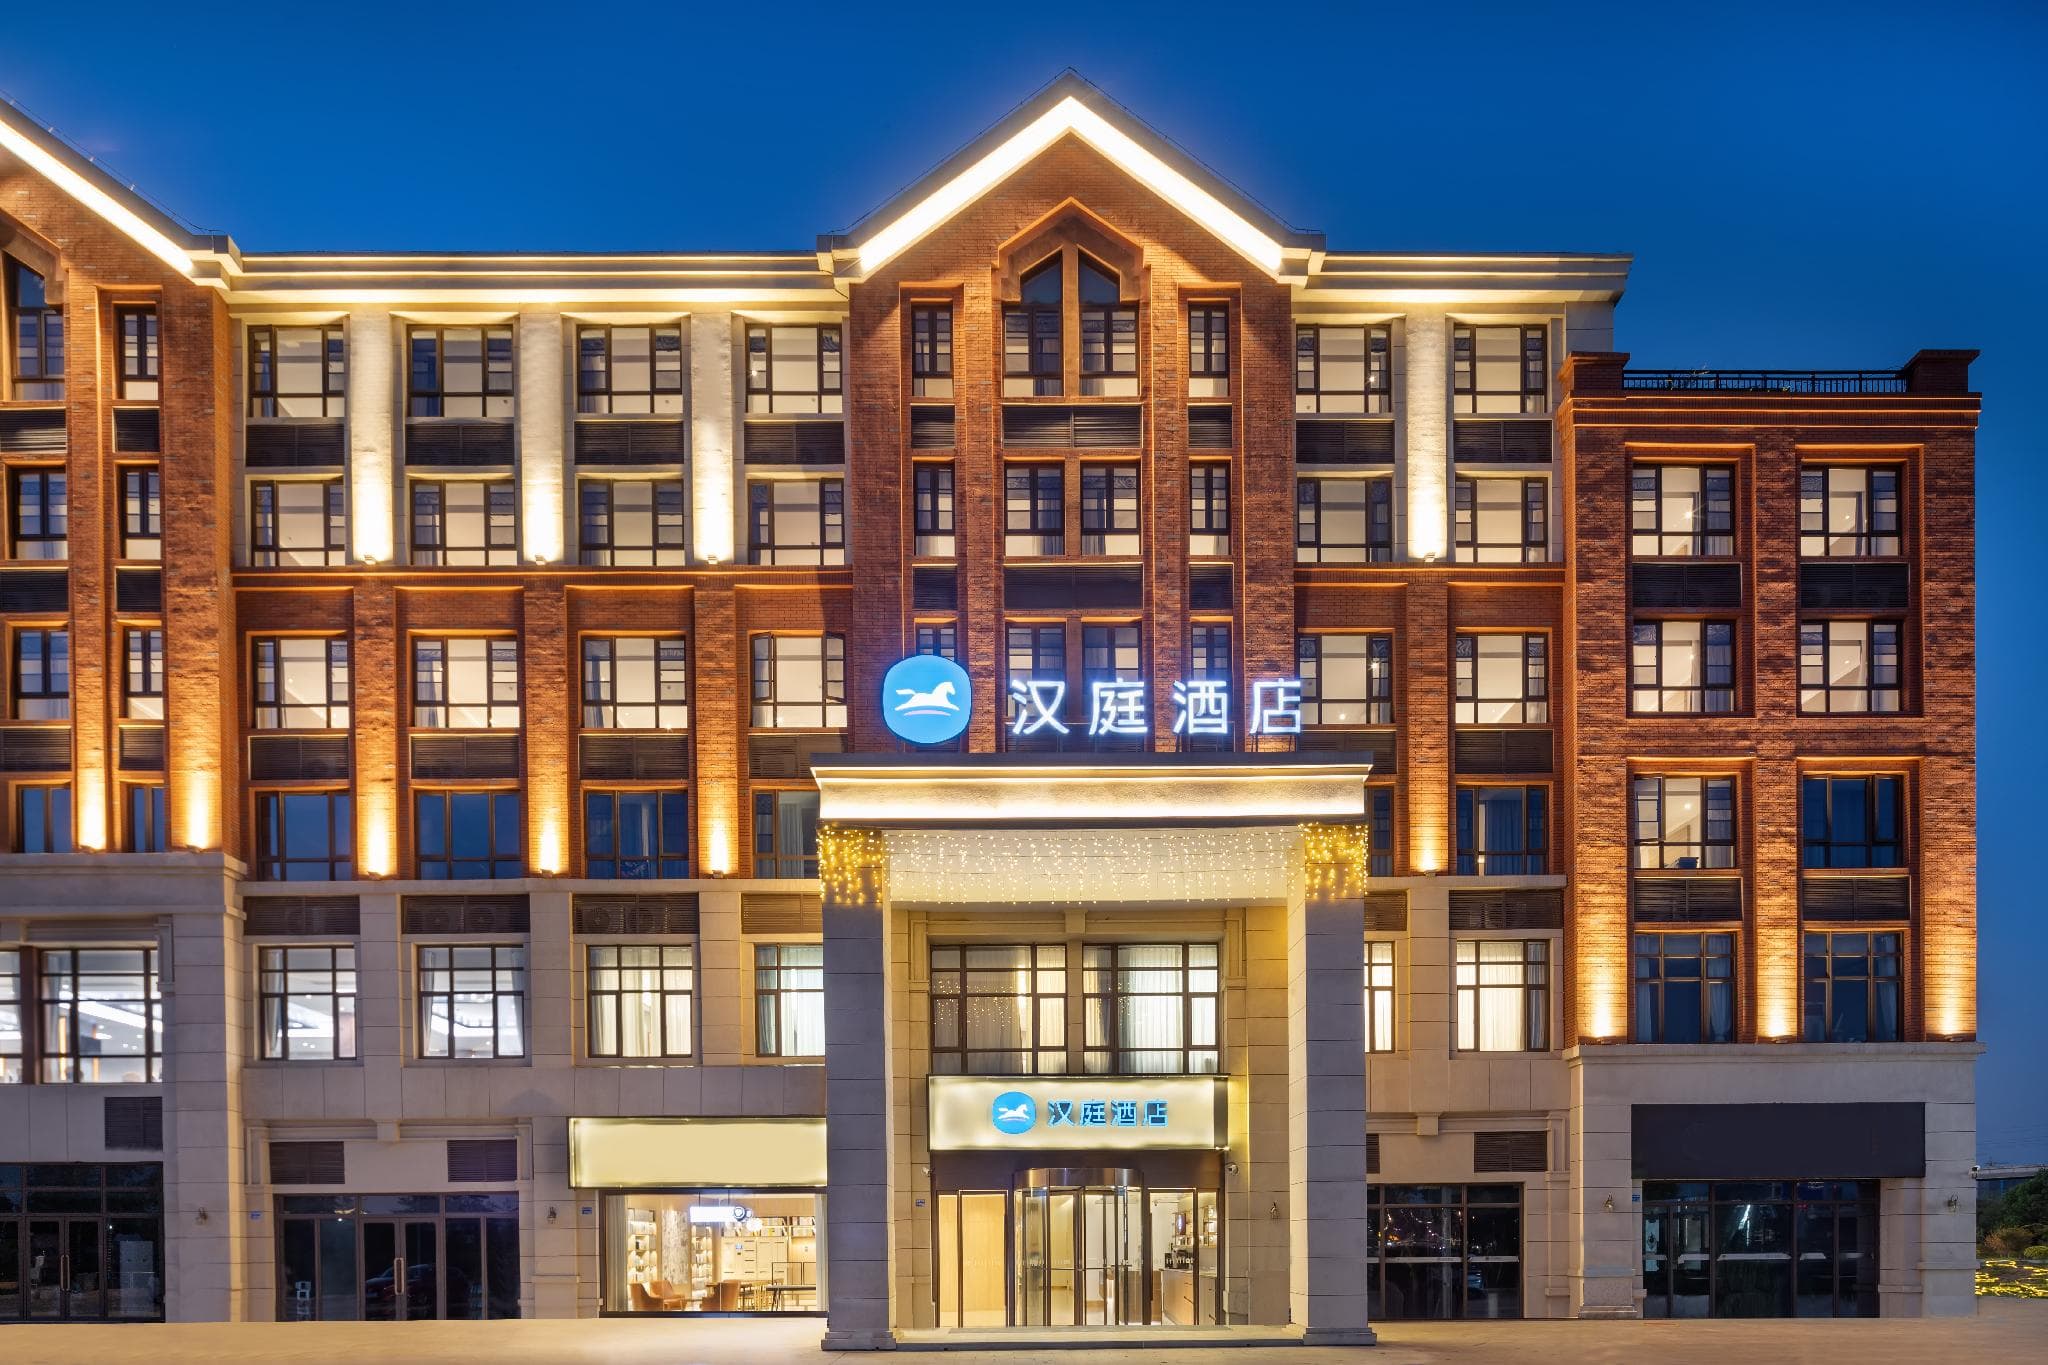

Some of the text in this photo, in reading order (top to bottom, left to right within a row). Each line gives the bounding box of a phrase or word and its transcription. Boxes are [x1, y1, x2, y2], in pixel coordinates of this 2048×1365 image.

[1011, 677, 1302, 735] 汉庭酒店
[1047, 1098, 1169, 1127] 汉庭酒店
